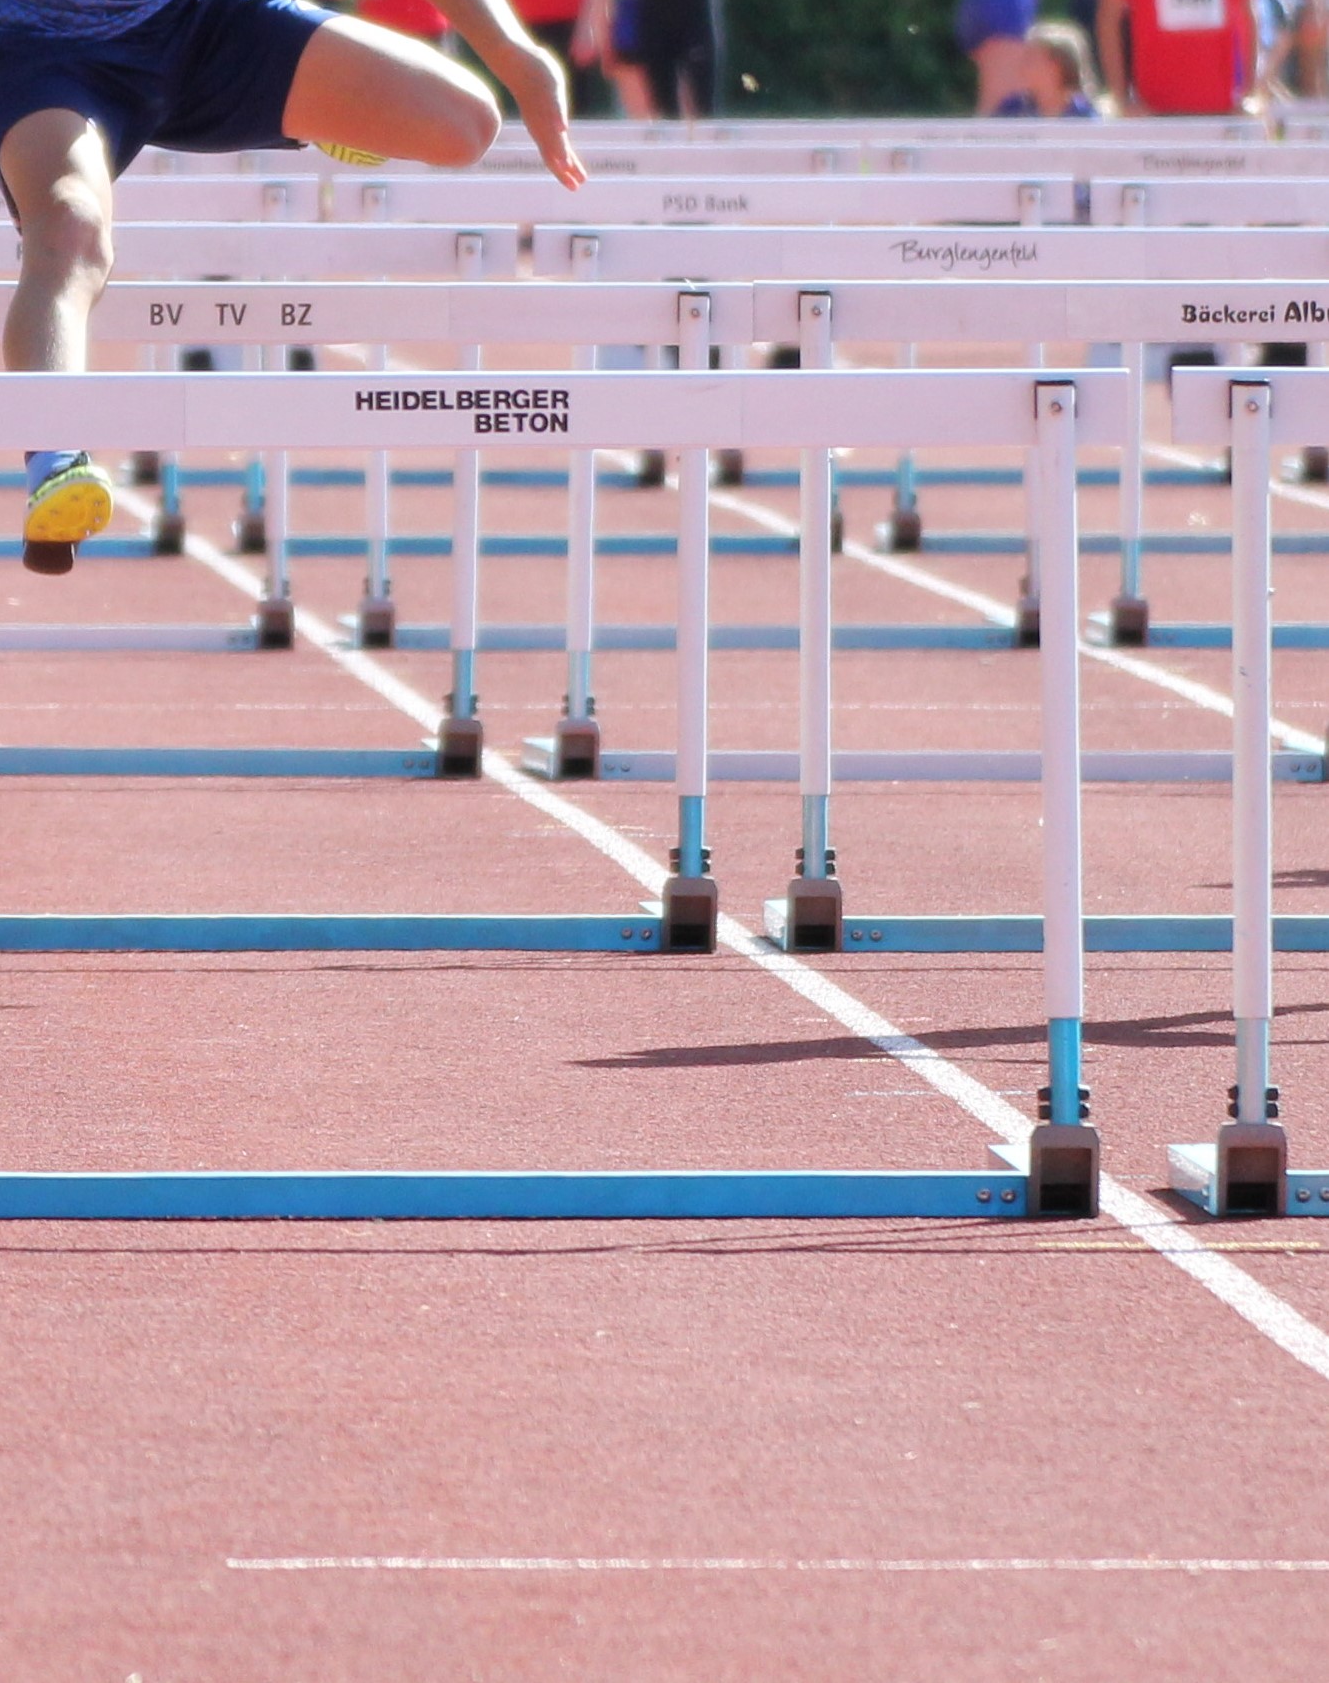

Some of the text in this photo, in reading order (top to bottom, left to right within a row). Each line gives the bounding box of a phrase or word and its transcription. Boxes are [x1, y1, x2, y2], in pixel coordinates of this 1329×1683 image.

[663, 195, 749, 212] PSD Bank
[891, 238, 1037, 270] Burglengenfeld
[150, 303, 312, 326] BV TV BZ
[1181, 301, 1329, 324] Bäckerei Alb
[355, 389, 569, 410] HEIDELBERGER
[474, 413, 568, 433] BETON
